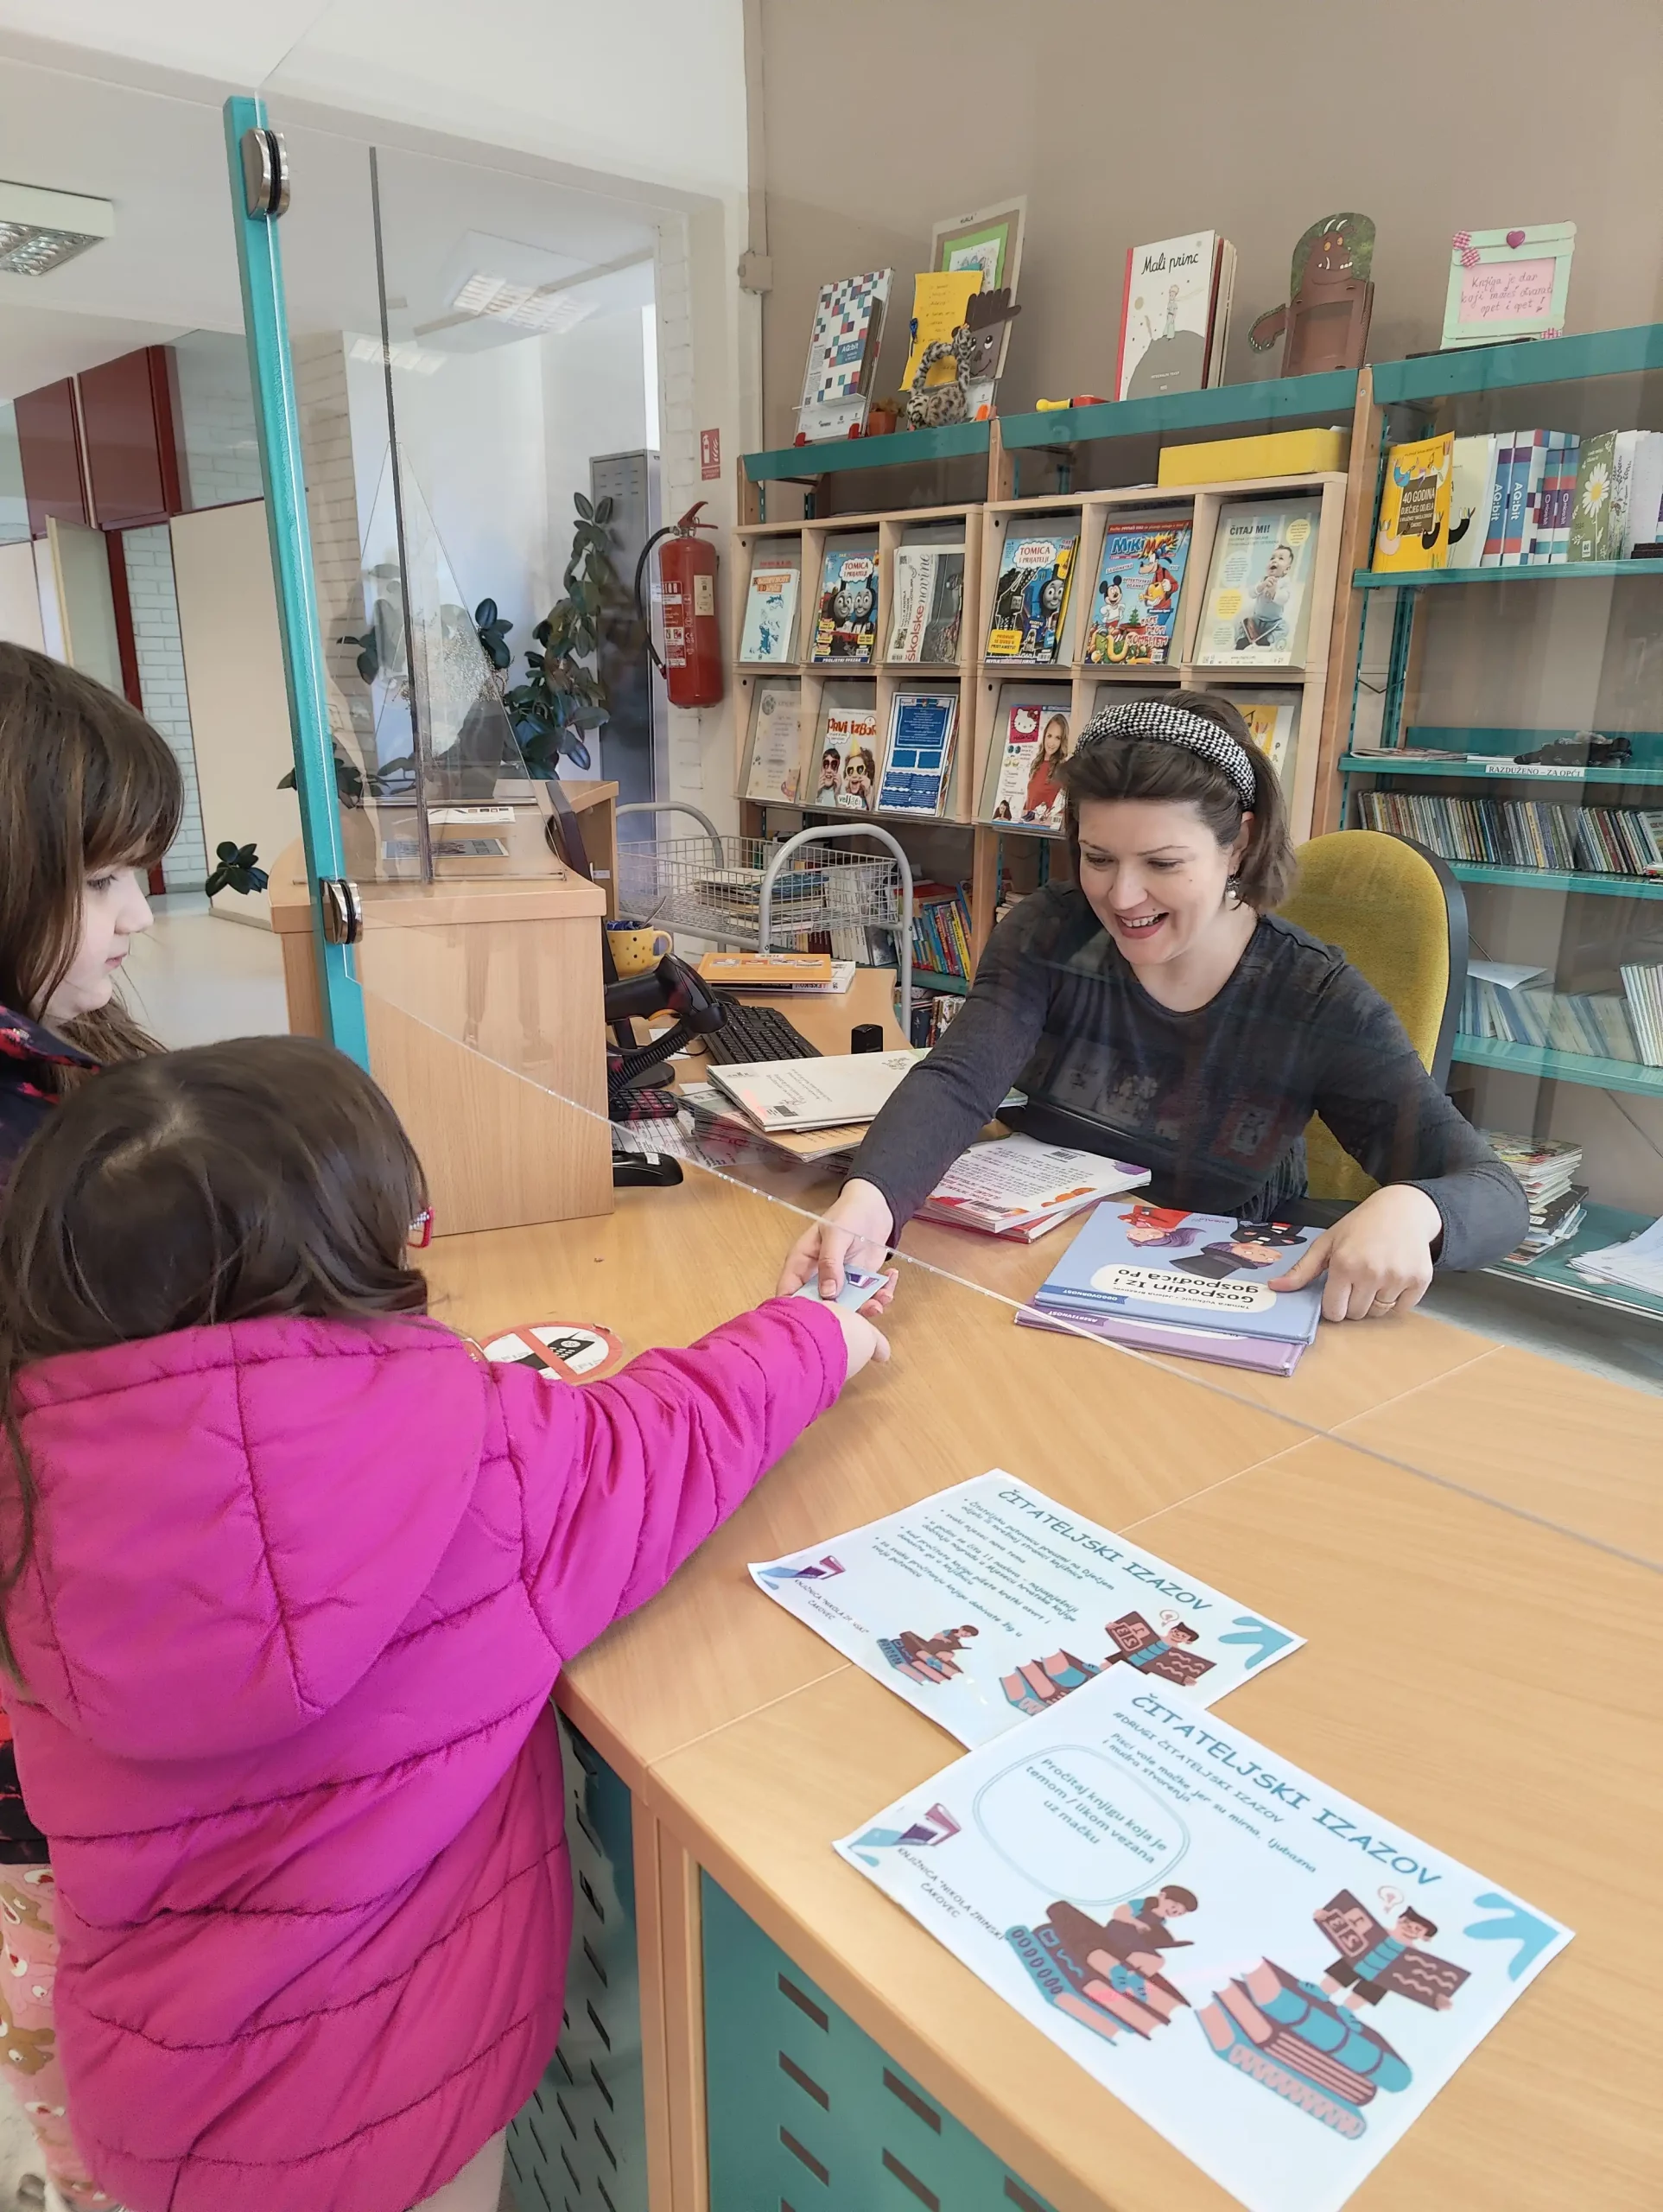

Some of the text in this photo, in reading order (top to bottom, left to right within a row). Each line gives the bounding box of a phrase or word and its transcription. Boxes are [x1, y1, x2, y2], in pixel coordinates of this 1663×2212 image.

[1141, 252, 1199, 275] Mali princ
[1471, 271, 1538, 292] Knjiga je dar
[1461, 290, 1484, 308] koji
[1481, 302, 1501, 317] opet
[1514, 299, 1533, 314] opet
[1402, 486, 1435, 504] 40 GODINA
[1490, 483, 1503, 521] AQ:bit
[1511, 482, 1524, 520] AQ:bit
[1560, 502, 1569, 524] micro:bit
[1229, 524, 1271, 536] ČITAJ MI!
[1019, 546, 1050, 556] TOMICA
[845, 562, 869, 570] TOMICA
[904, 553, 930, 662] školske novine
[1488, 765, 1539, 775] RAZDUŽENO
[1118, 1268, 1260, 1294] gospođica Po
[1126, 1279, 1147, 1288] Iz
[1063, 1288, 1118, 1301] ODGOVORNOST
[1153, 1283, 1254, 1304] Gospodin
[1048, 1310, 1098, 1323] ASERTIVNOST
[988, 1540, 1006, 1551] nova
[998, 1489, 1213, 1611] ČITATELJSKI IZAZOV
[1082, 1568, 1114, 1591] Dječjem
[998, 1589, 1024, 1605] kratki
[968, 1600, 1001, 1622] dobivate
[1051, 1604, 1076, 1622] knjige
[1109, 1744, 1142, 1768] mudra
[1112, 1711, 1285, 1824] #DRUGI ČITATELJSKI IZAZOV
[1131, 1692, 1443, 1887] ČITATELJSKI IZAZOV
[1040, 1758, 1169, 1854] Pročitaj knjigu koja je
[1110, 1732, 1136, 1750] Pisci
[1136, 1749, 1158, 1766] vole
[1157, 1764, 1192, 1791] mačke
[1190, 1787, 1212, 1804] jer
[1213, 1802, 1227, 1815] su
[1266, 1836, 1317, 1873] ljubazna
[1025, 1765, 1070, 1801] temom
[1076, 1802, 1110, 1831] likom
[1109, 1830, 1156, 1865] vezana
[1044, 1799, 1101, 1846] uz mačku
[897, 1847, 938, 1883] KNJIŽNICA
[919, 1881, 961, 1919] ČAKOVEC
